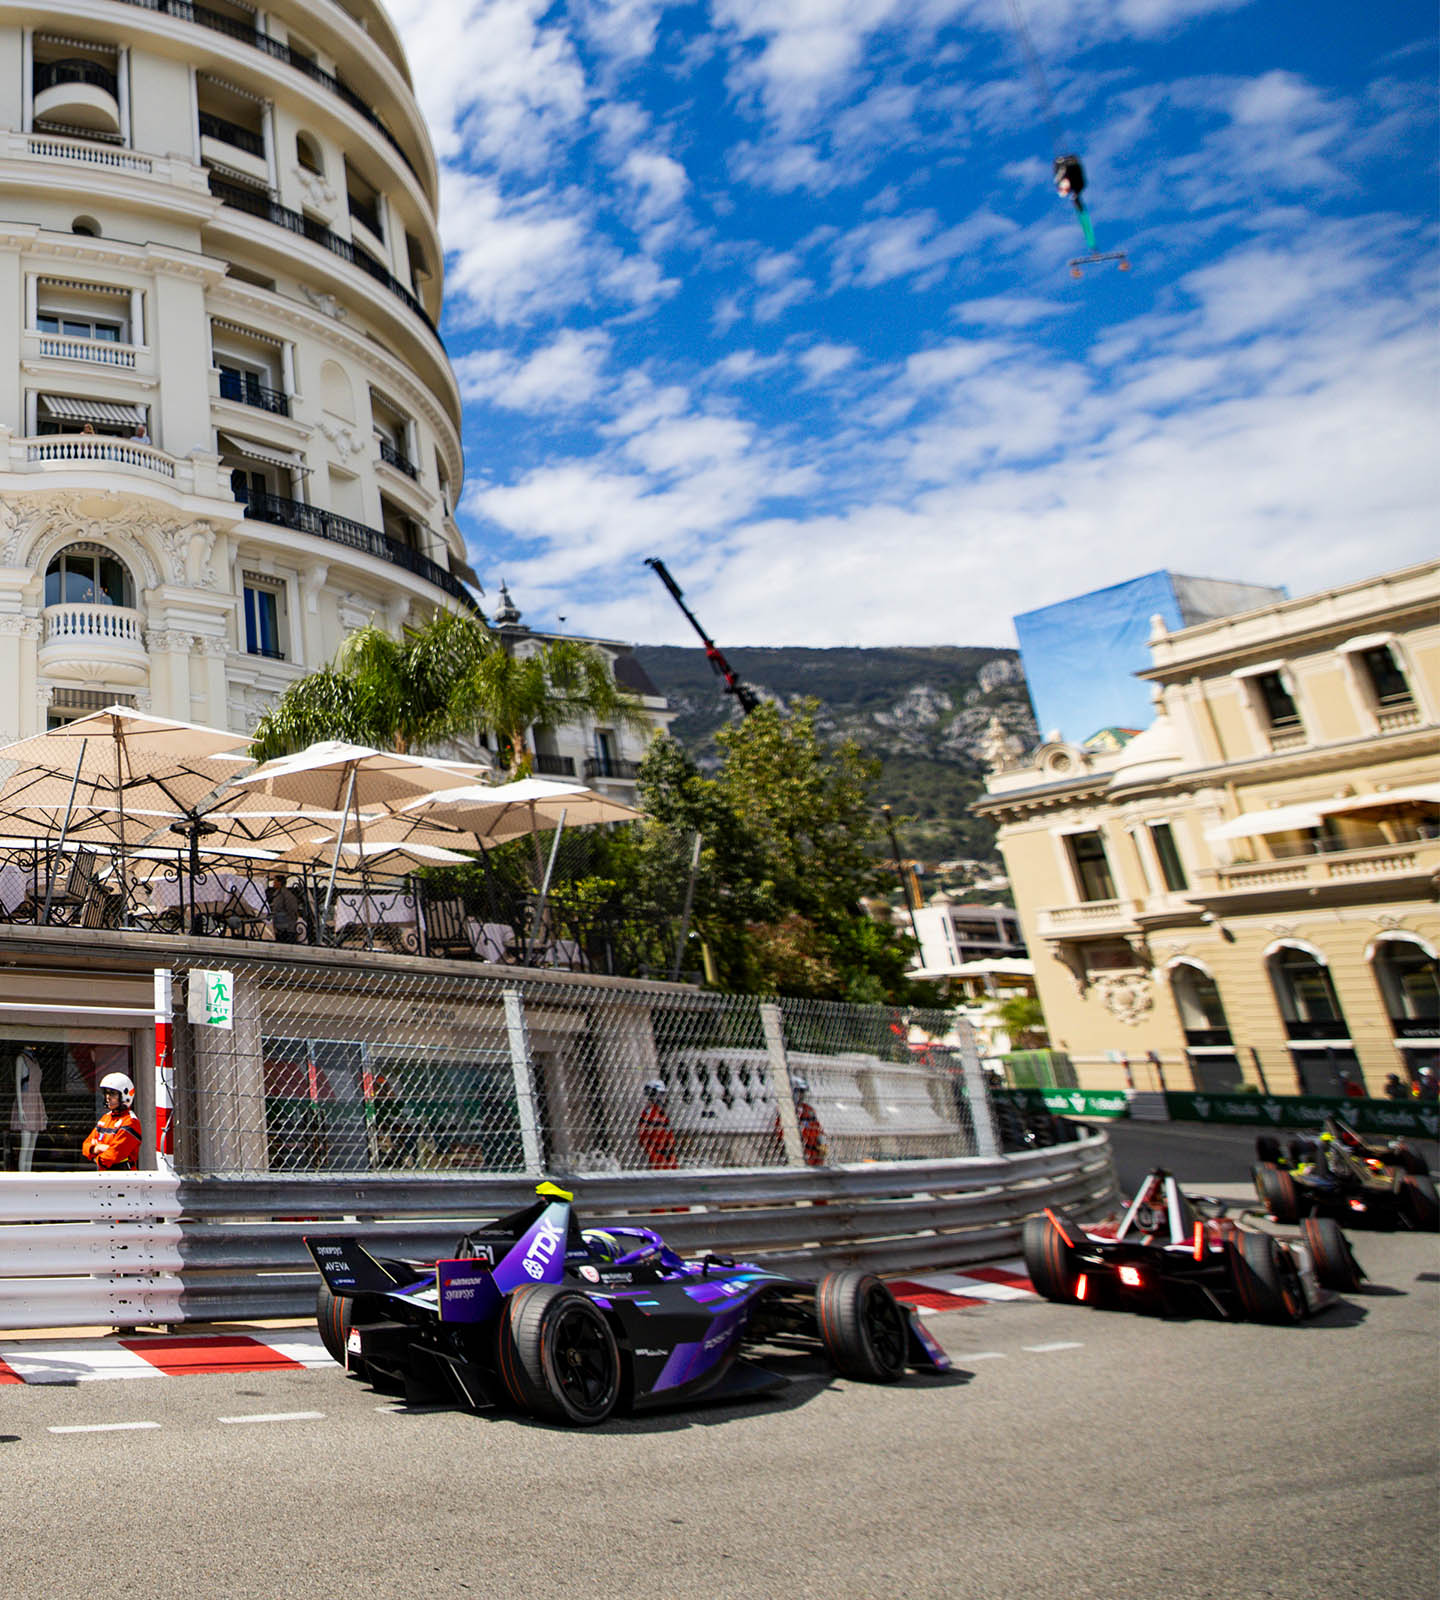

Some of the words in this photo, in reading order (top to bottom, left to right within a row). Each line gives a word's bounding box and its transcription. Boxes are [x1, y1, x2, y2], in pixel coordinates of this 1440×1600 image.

[205, 1005, 229, 1015] EXIT
[527, 1218, 564, 1265] TDK
[324, 1261, 351, 1272] AVEVA
